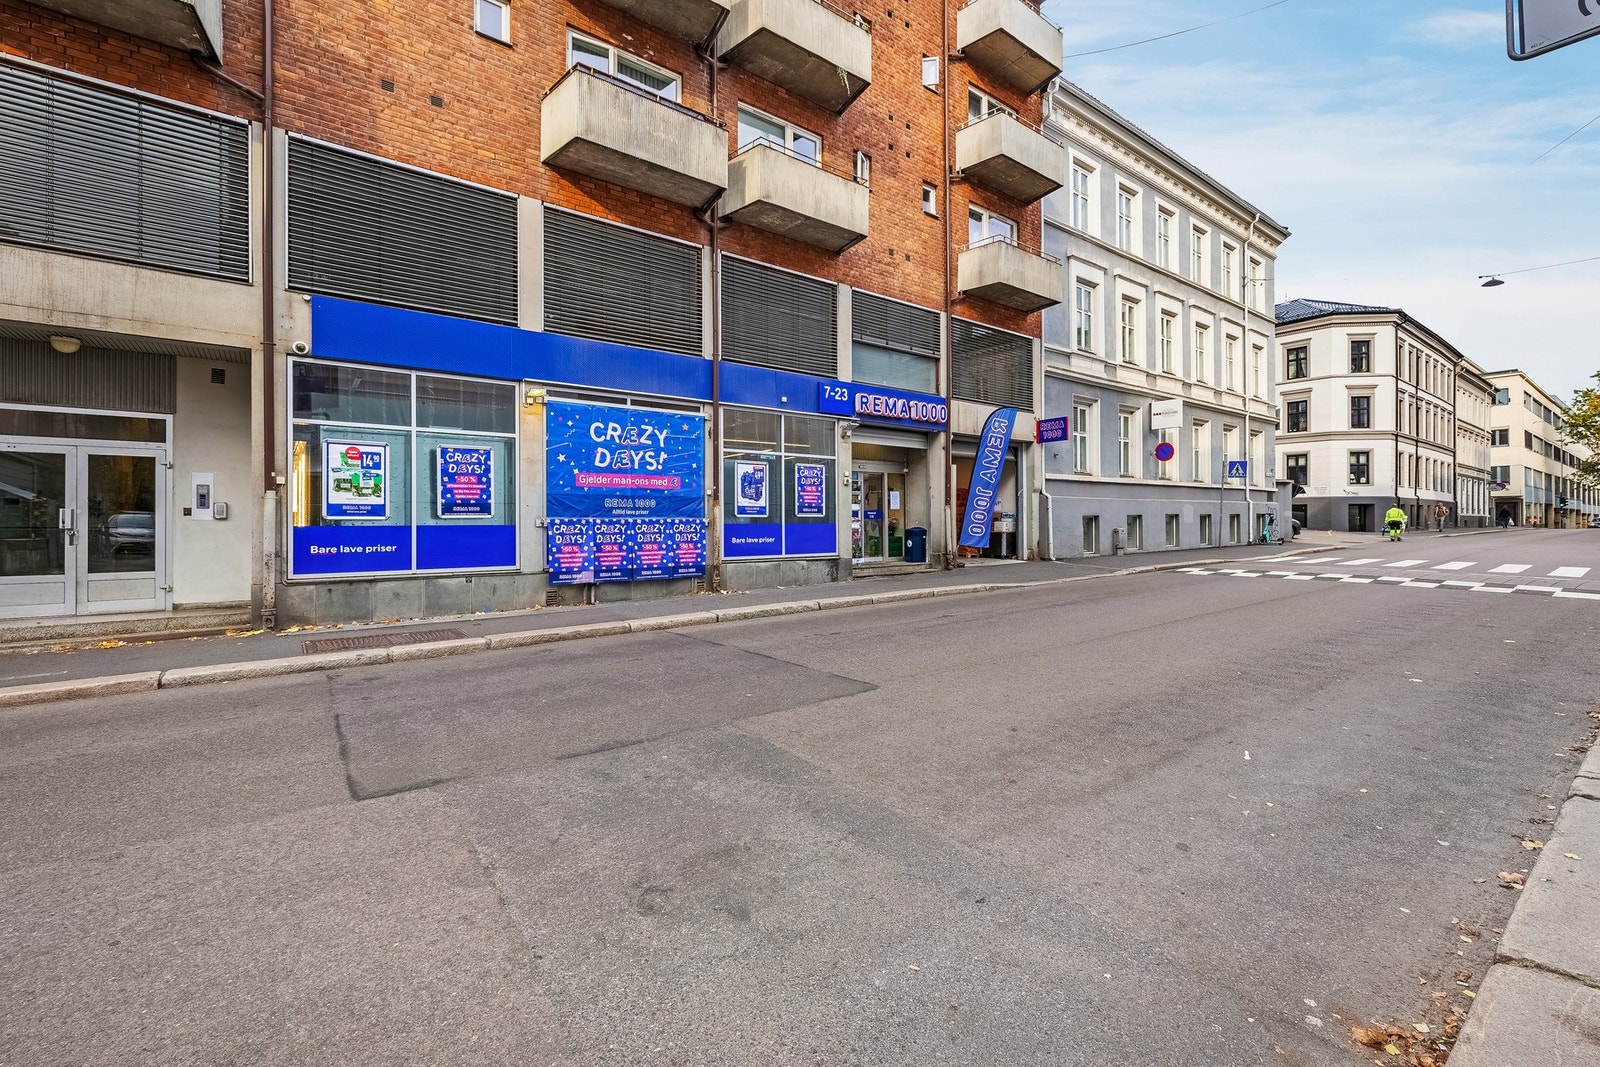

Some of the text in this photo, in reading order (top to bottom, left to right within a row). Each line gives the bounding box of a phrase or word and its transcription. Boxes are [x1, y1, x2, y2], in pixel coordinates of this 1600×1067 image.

[824, 386, 848, 400] 7-23
[857, 393, 947, 422] REMA 1000
[1040, 420, 1064, 431] REMA
[590, 422, 667, 448] CRÆZY
[1043, 430, 1062, 440] 1000
[363, 454, 373, 467] 14
[580, 475, 610, 485] Gjelder
[613, 477, 648, 485] man-ons
[651, 478, 668, 486] med
[605, 499, 656, 508] REMA 1000
[310, 545, 337, 554] Bare
[366, 544, 397, 554] priser
